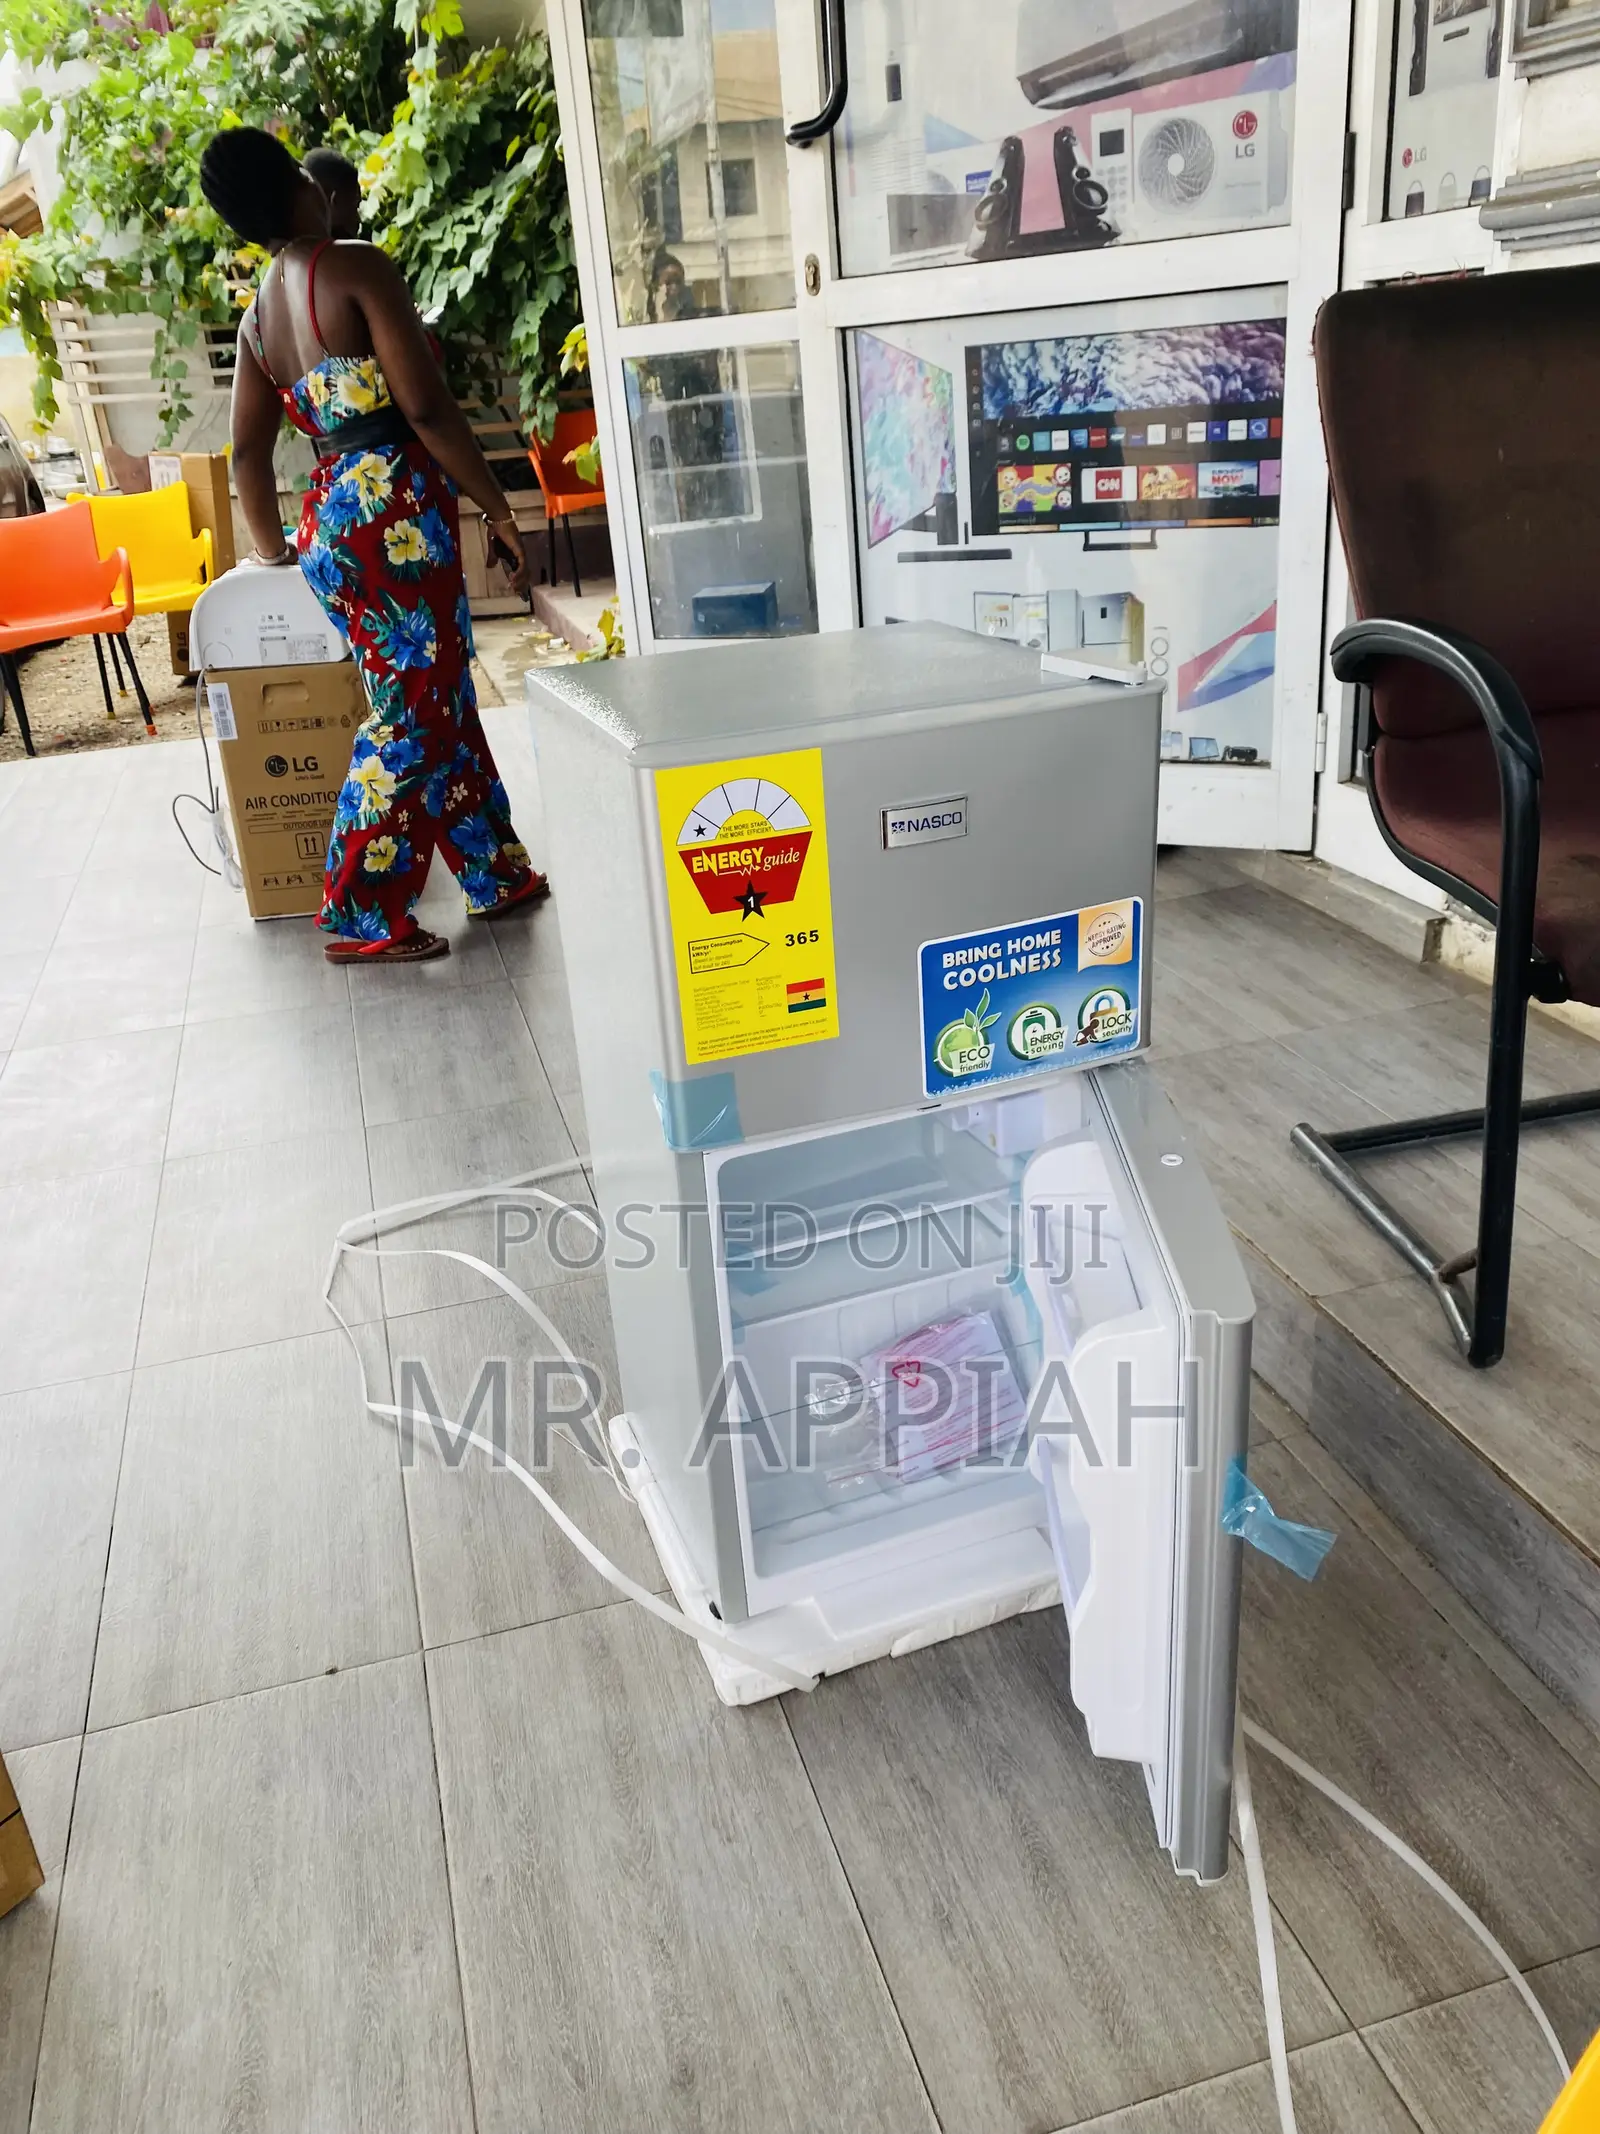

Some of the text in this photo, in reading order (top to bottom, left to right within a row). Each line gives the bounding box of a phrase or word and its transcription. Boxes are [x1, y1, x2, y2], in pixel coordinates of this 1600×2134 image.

[1235, 143, 1256, 159] LG
[1414, 147, 1427, 163] LG
[1097, 478, 1120, 491] CNN
[177, 632, 187, 646] LG
[292, 755, 318, 773] LG
[245, 790, 341, 810] AIR CONDITIO
[734, 823, 749, 831] MORE
[750, 821, 768, 829] STARS
[907, 811, 963, 833] NASCO
[746, 826, 772, 836] EFFICIENT
[692, 846, 800, 876] ENERGY guide
[747, 896, 755, 908] 1
[785, 929, 819, 947] 365
[1085, 921, 1127, 944] NERGY RATING
[1092, 931, 1122, 949] APPROVED
[691, 939, 743, 952] Energy Consumption
[942, 929, 1062, 969] BRING HOME
[943, 948, 1062, 991] COOLNESS
[1101, 1012, 1132, 1030] LOCK
[1030, 1030, 1065, 1047] ENERGY
[1102, 1025, 1132, 1038] security
[959, 1046, 991, 1064] ECO
[1031, 1041, 1064, 1055] saving
[960, 1060, 991, 1073] friendly
